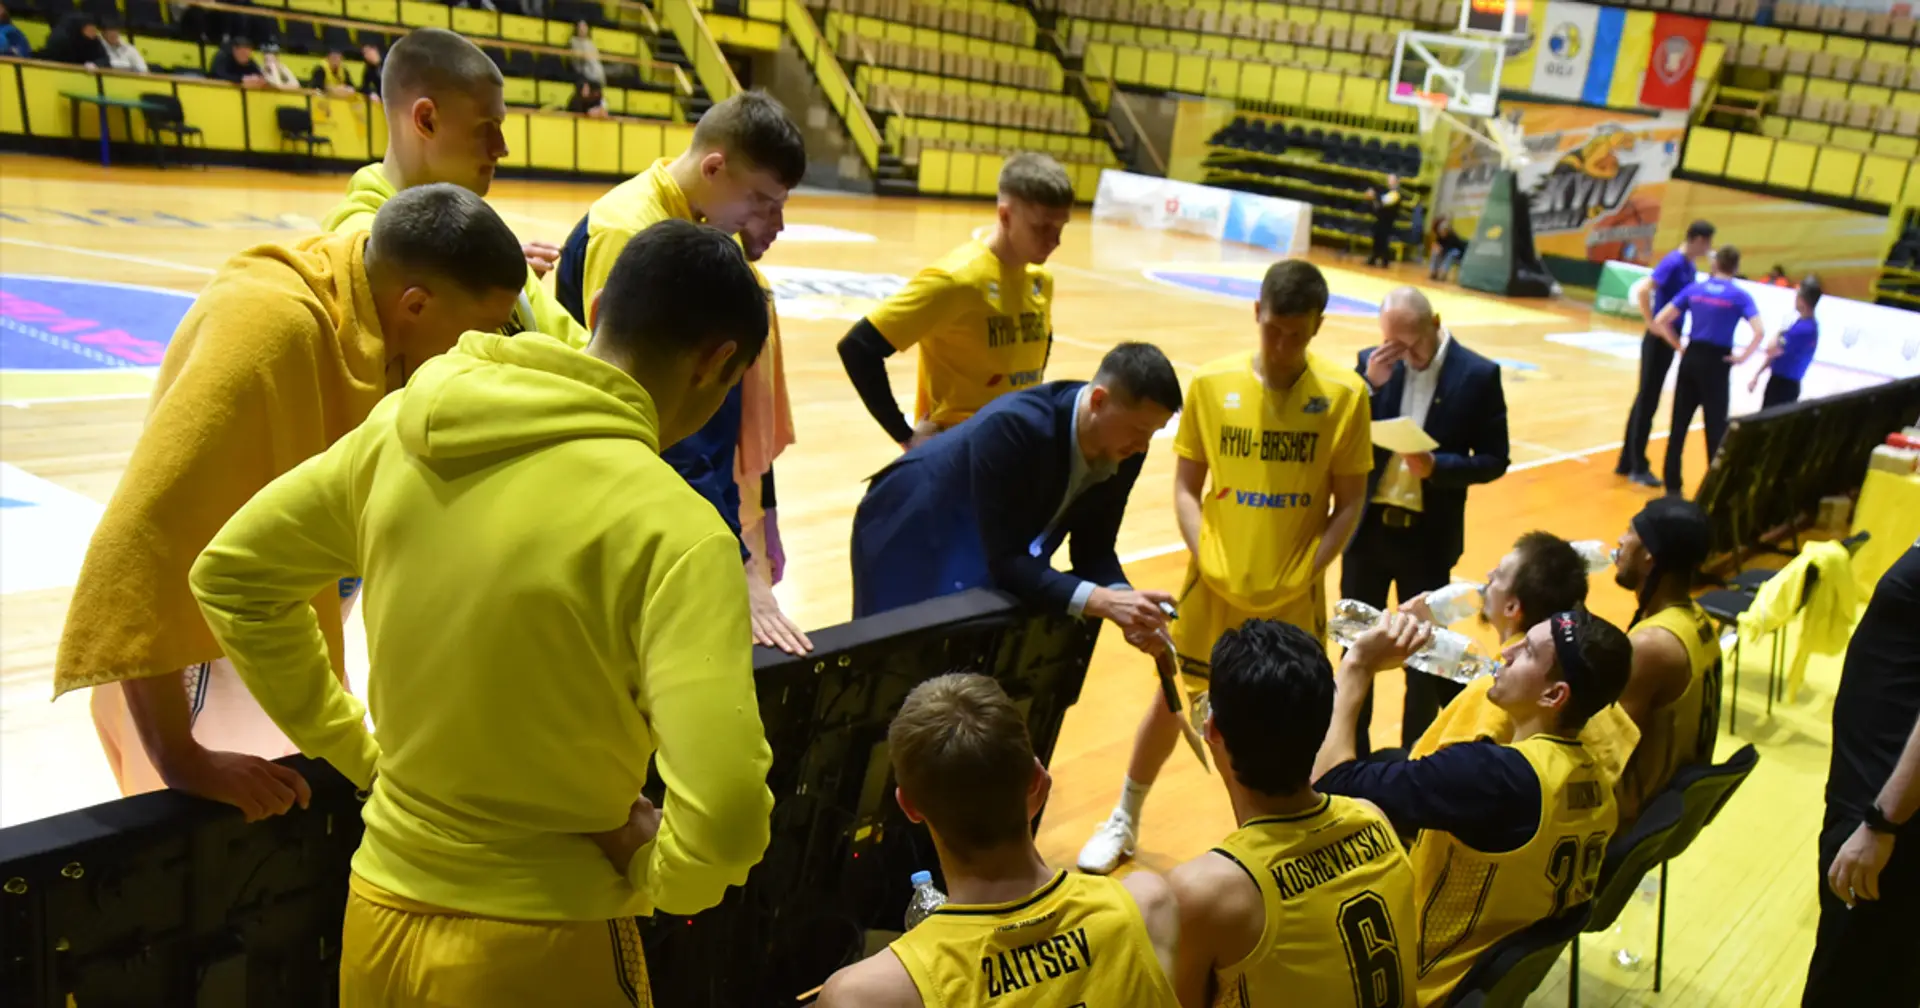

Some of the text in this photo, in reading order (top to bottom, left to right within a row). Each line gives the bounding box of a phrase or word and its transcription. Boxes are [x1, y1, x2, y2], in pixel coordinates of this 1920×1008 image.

[1236, 490, 1311, 508] VENETO
[1271, 820, 1395, 900] KOSHEVATSKYI
[981, 927, 1092, 998] ZAITSEV
[1337, 890, 1404, 1008] 6
